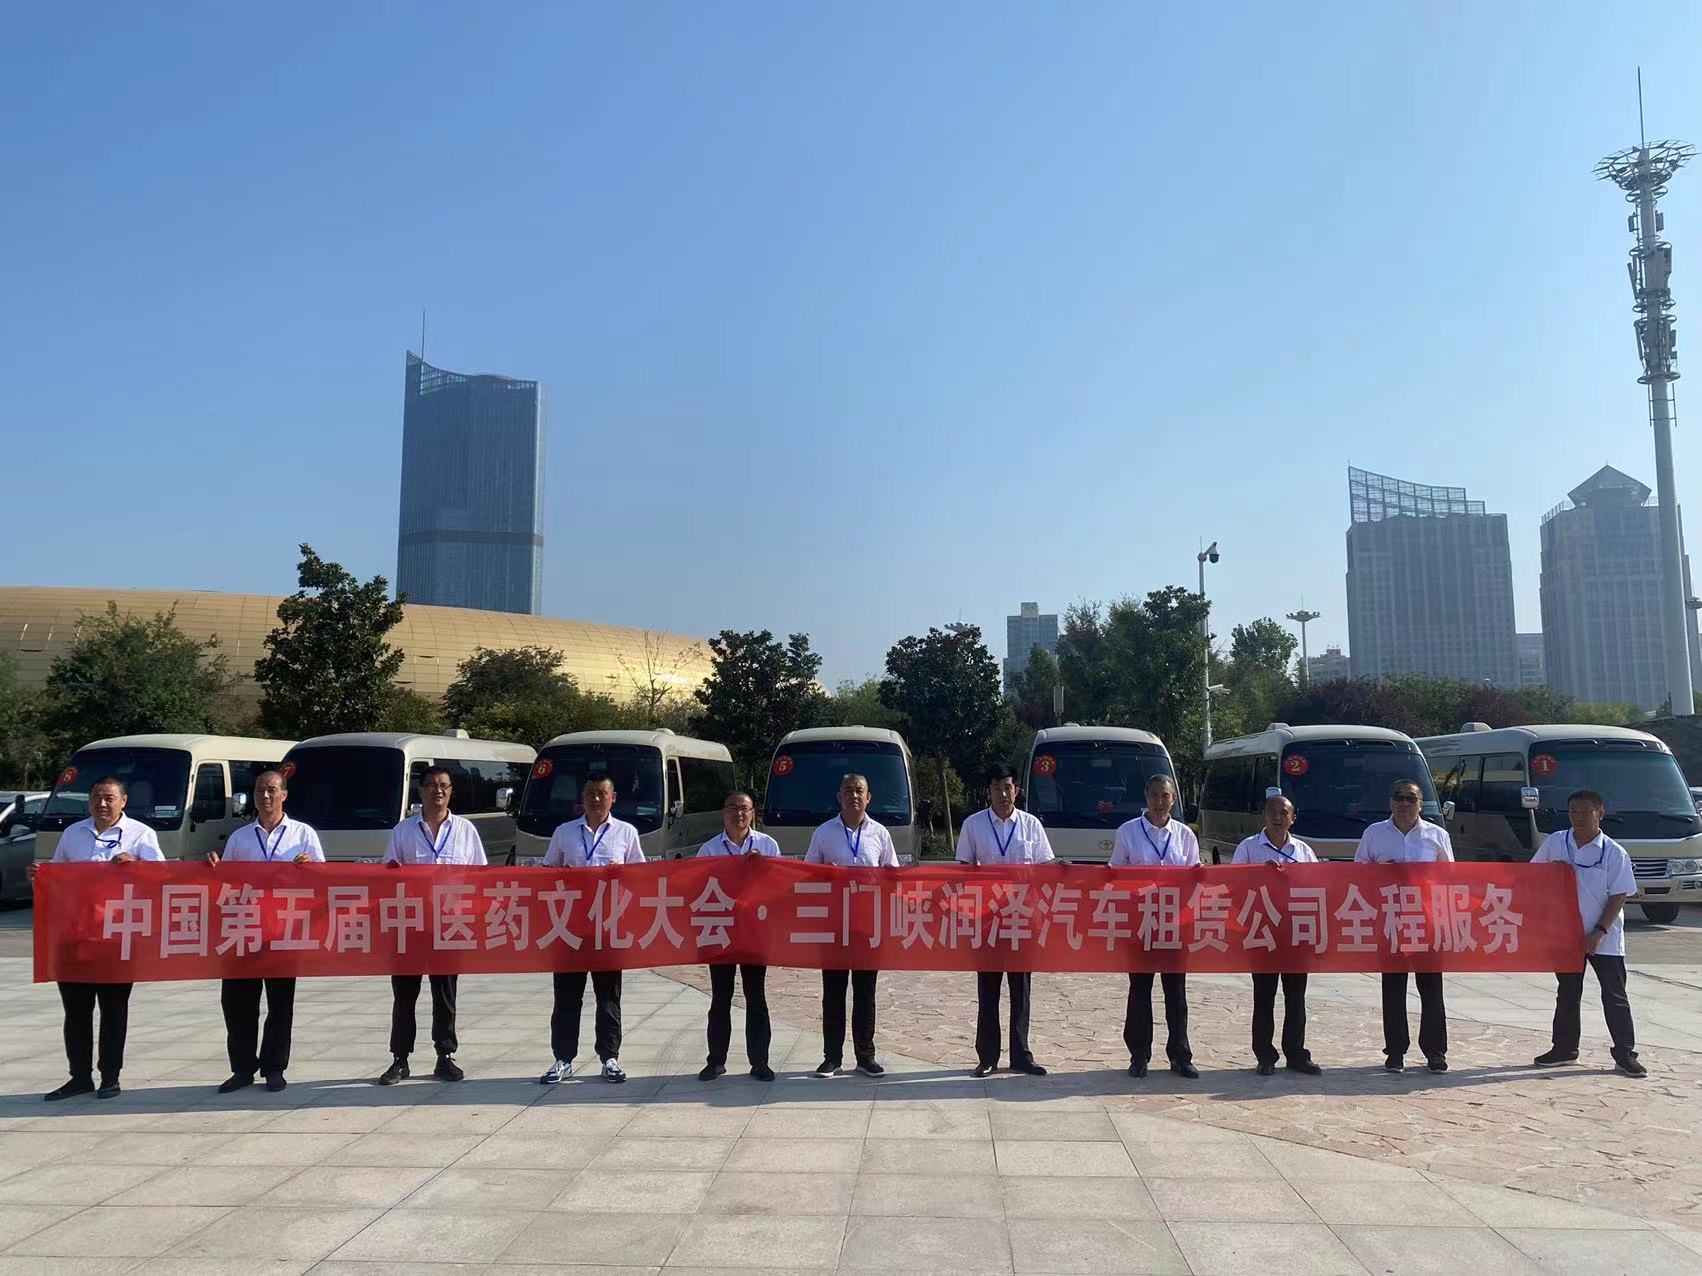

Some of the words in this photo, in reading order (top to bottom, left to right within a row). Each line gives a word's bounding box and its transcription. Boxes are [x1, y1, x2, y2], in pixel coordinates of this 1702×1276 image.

[538, 764, 546, 774] 6
[779, 761, 787, 771] 5
[1040, 760, 1049, 771] 3
[1291, 760, 1300, 771] 2
[1540, 760, 1549, 771] 1
[63, 771, 72, 783] 8
[102, 876, 1523, 960] 中国第五届中医药文化大会·三门峡润泽汽车租赁公司全程服务
